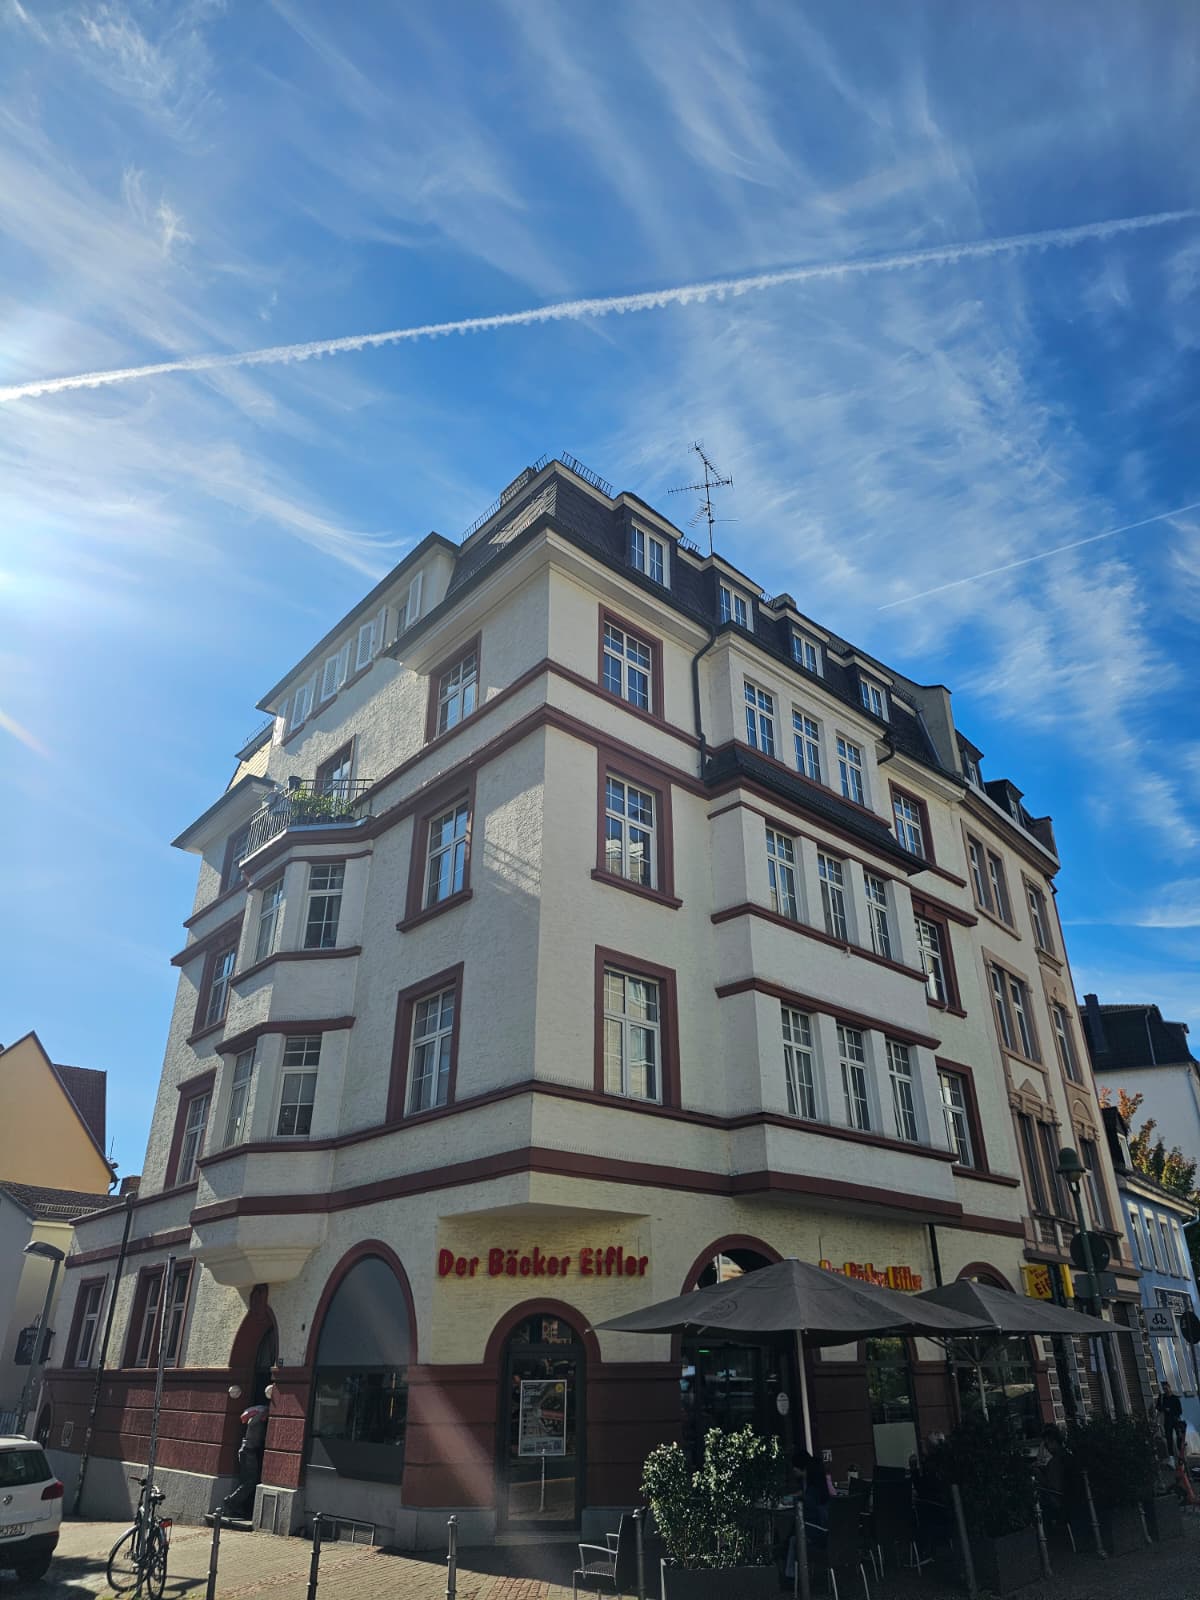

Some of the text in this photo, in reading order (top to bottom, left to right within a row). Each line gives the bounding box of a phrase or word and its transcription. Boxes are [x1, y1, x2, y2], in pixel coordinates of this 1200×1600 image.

[438, 1246, 649, 1277] Der Bäcker Eifler
